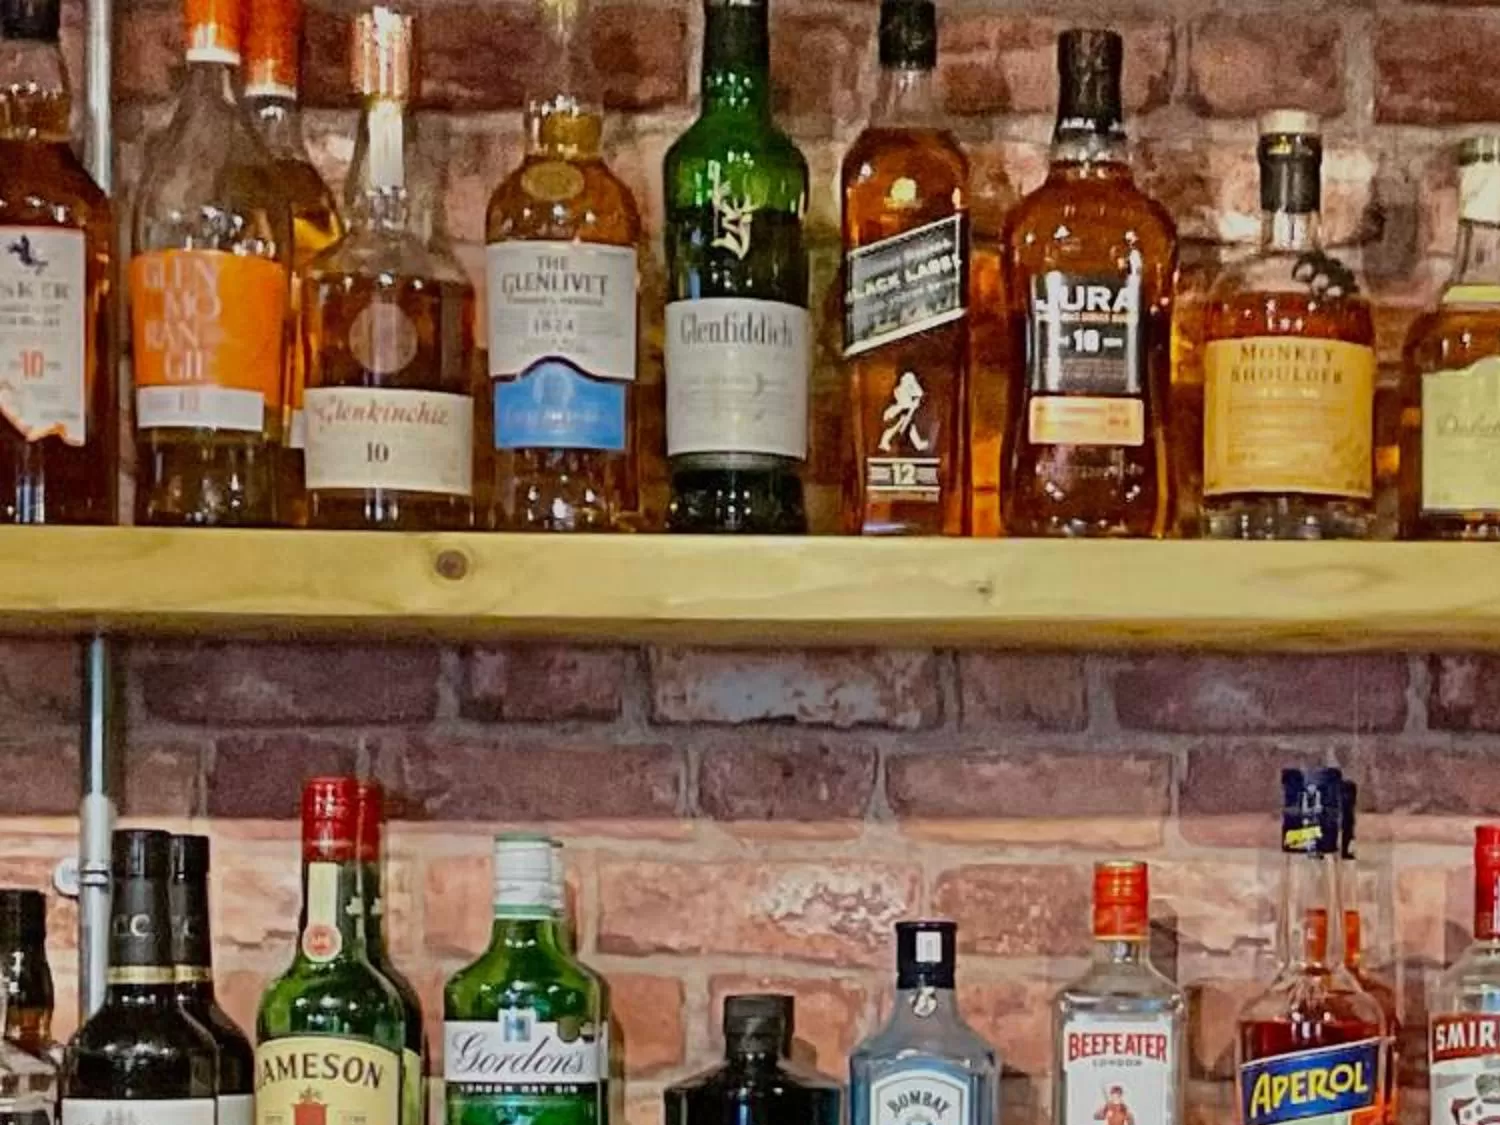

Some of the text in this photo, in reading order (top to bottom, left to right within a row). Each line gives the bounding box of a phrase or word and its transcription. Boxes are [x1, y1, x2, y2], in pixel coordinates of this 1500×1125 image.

[538, 255, 568, 270] THE
[503, 272, 608, 297] GLENLIVET
[680, 311, 793, 348] Glenfiddich
[1241, 343, 1333, 363] MONKEY
[366, 441, 389, 463] 10
[892, 462, 916, 485] 12
[452, 1032, 583, 1075] Gordon's
[1068, 1032, 1167, 1063] BEEFEATER
[256, 1053, 384, 1090] JAMESON
[1251, 1061, 1369, 1118] APEROL
[886, 1090, 951, 1119] BOMBAY
